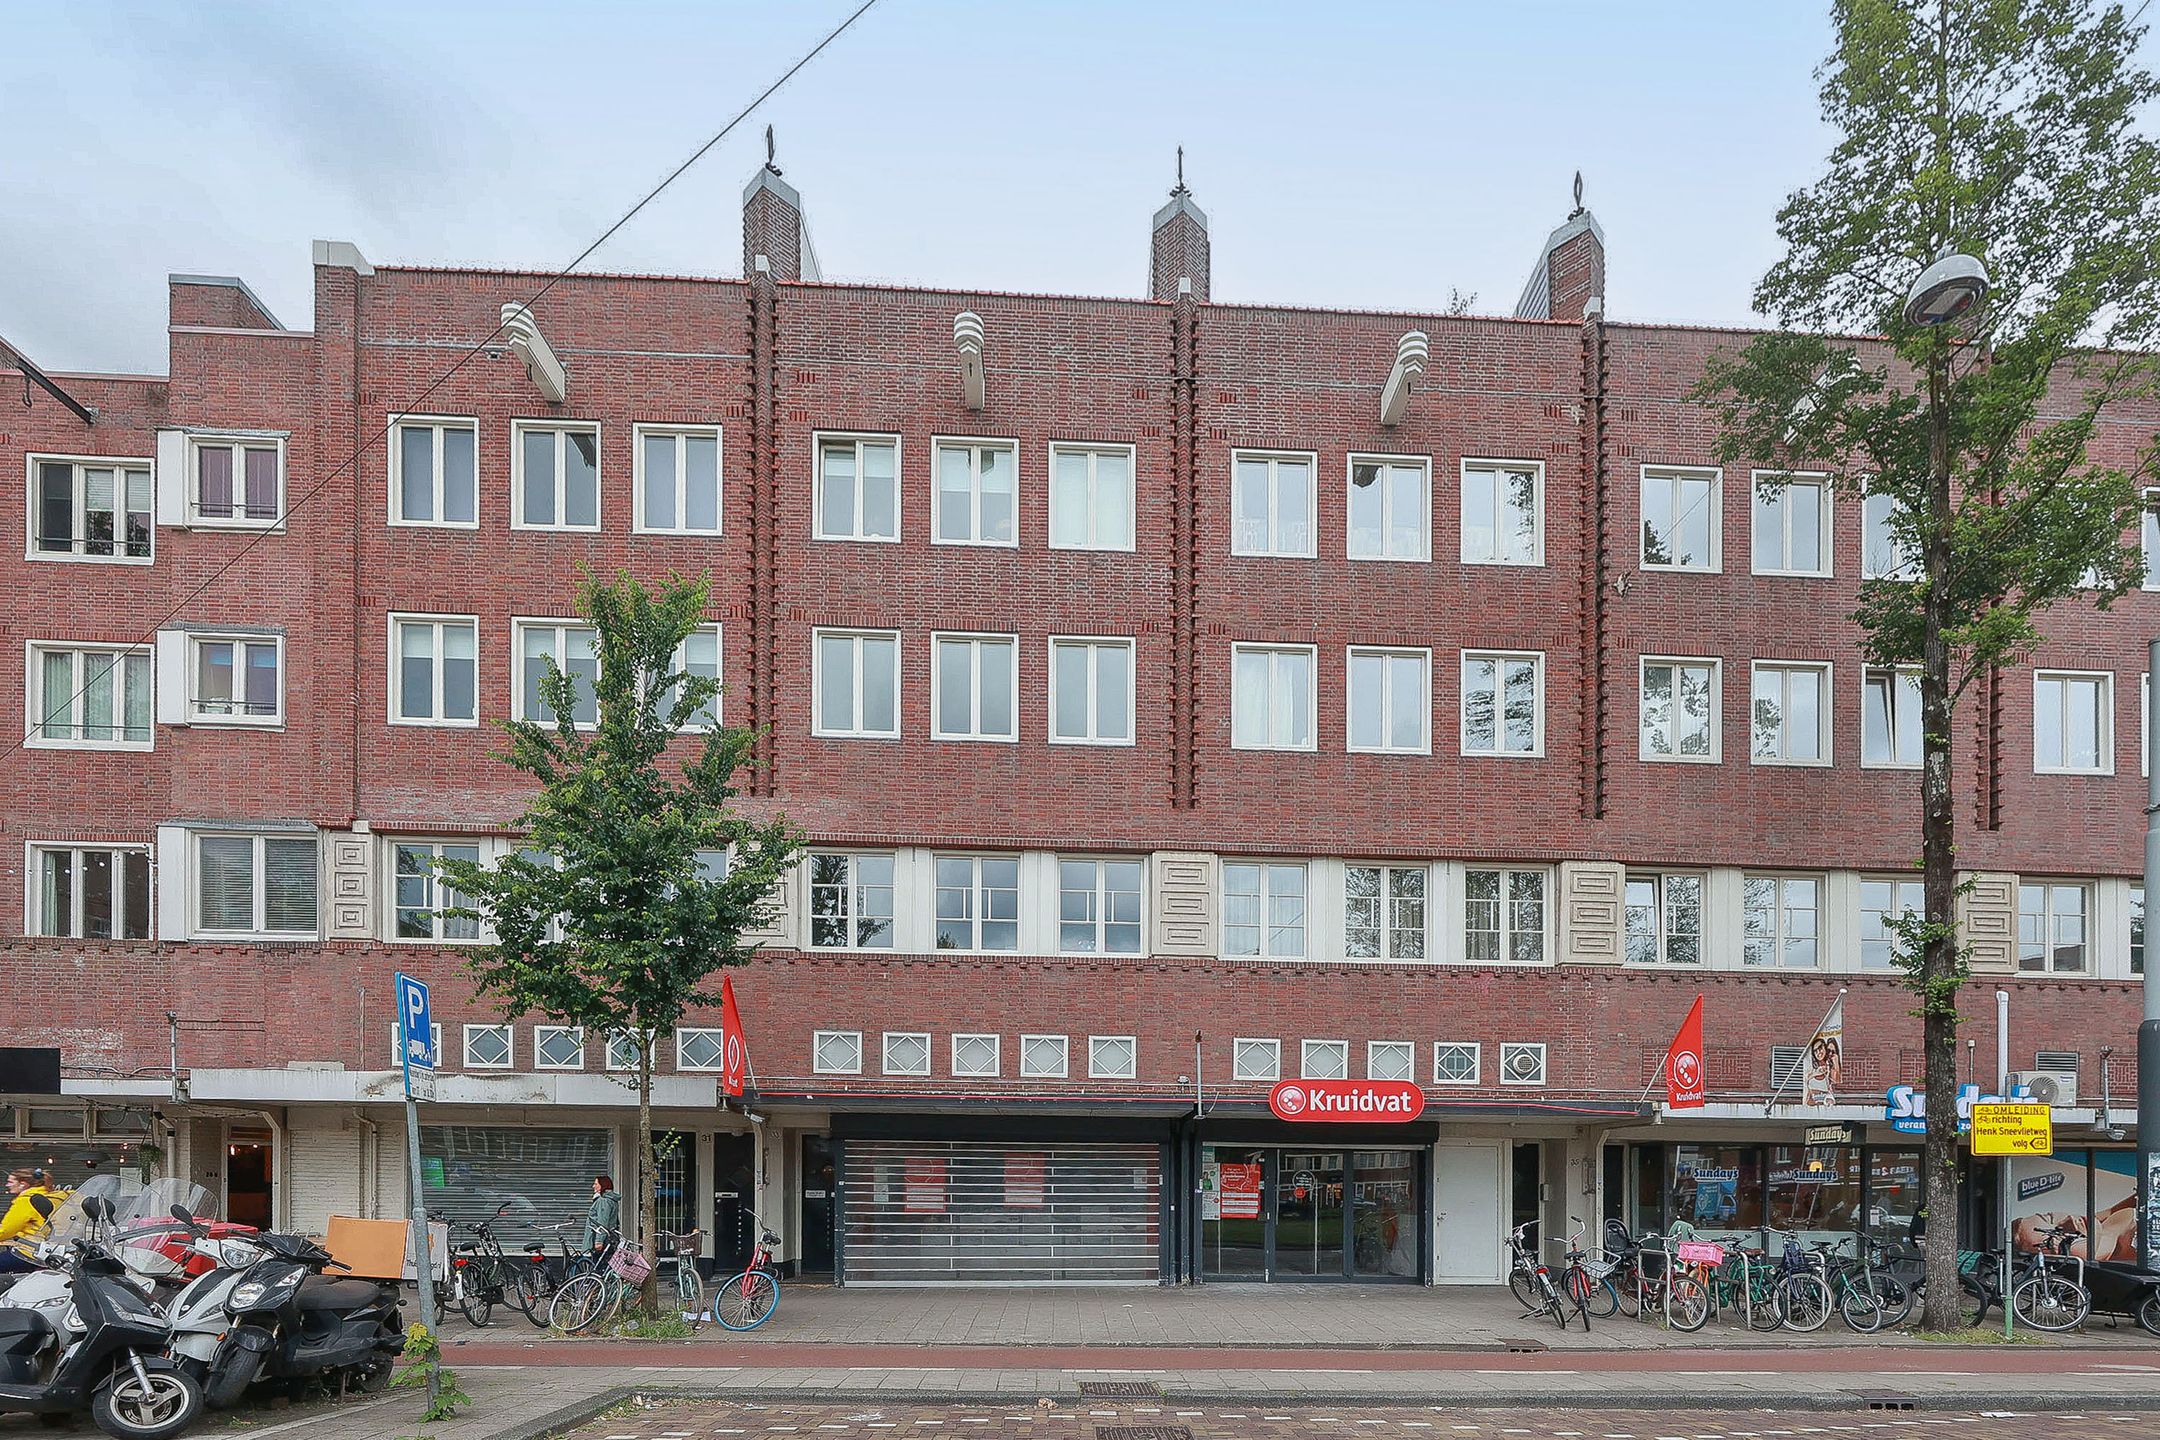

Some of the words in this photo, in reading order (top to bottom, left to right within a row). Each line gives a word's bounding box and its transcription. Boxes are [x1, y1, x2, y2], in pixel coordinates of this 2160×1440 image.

[407, 984, 424, 1029] P
[1309, 1089, 1412, 1112] Kruidvat
[1676, 1091, 1702, 1102] Kruidvat
[1993, 1106, 2046, 1115] OMLEIDING
[1992, 1115, 2023, 1125] richting
[1976, 1127, 1998, 1136] Henk
[1999, 1126, 2048, 1137] Sneevlietweg
[701, 1133, 712, 1142] 31
[2012, 1139, 2028, 1149] volg
[1693, 1166, 1739, 1181] Sunday's
[1793, 1168, 1838, 1182] Sunday's
[2021, 1181, 2039, 1191] blue
